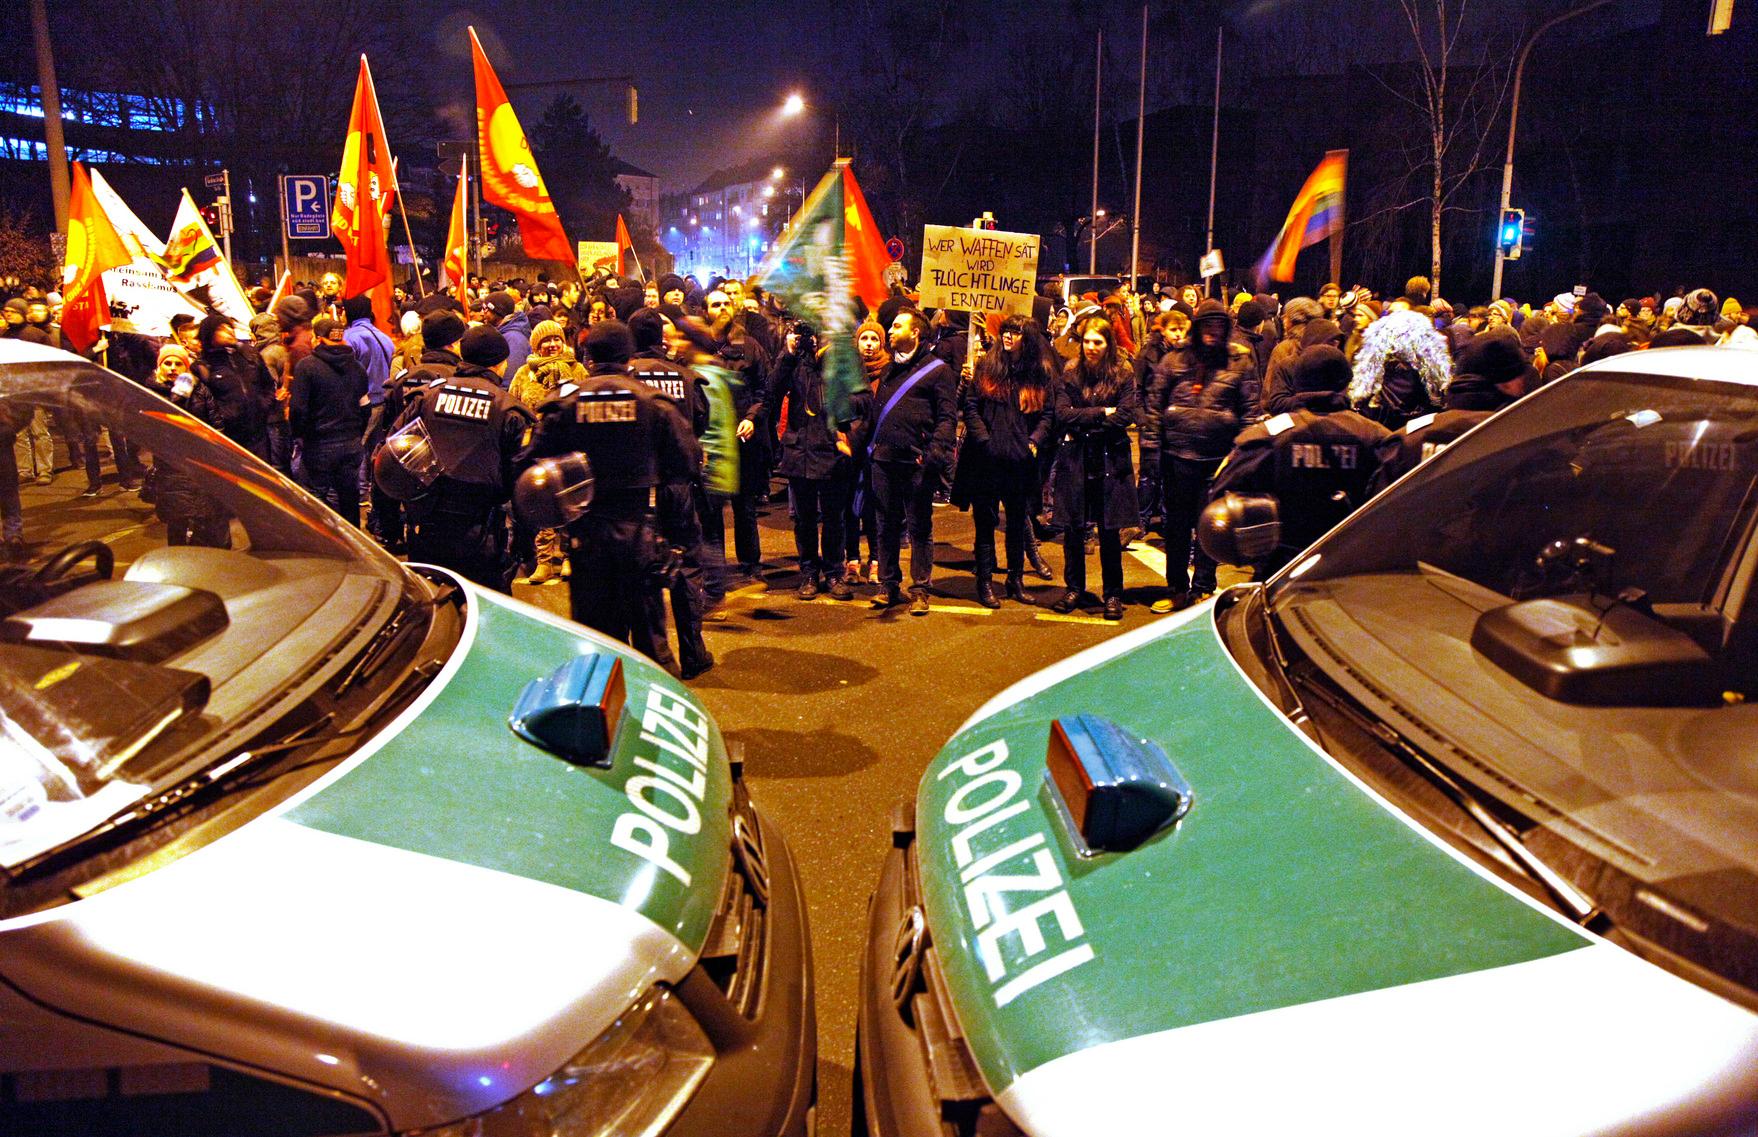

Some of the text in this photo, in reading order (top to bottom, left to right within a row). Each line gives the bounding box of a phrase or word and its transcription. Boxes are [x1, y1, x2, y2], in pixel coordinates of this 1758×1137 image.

[295, 180, 317, 212] P
[928, 237, 1036, 258] WER WAFFEN SÄT
[966, 260, 995, 272] WIRD
[931, 268, 1030, 295] FLÜCHTLINGE
[951, 292, 1005, 311] ERNTEN
[435, 393, 491, 420] POLIZEI
[1291, 443, 1358, 469] POLEI
[610, 683, 708, 887] POLIZEI
[937, 738, 1095, 1008] POLIZEI
